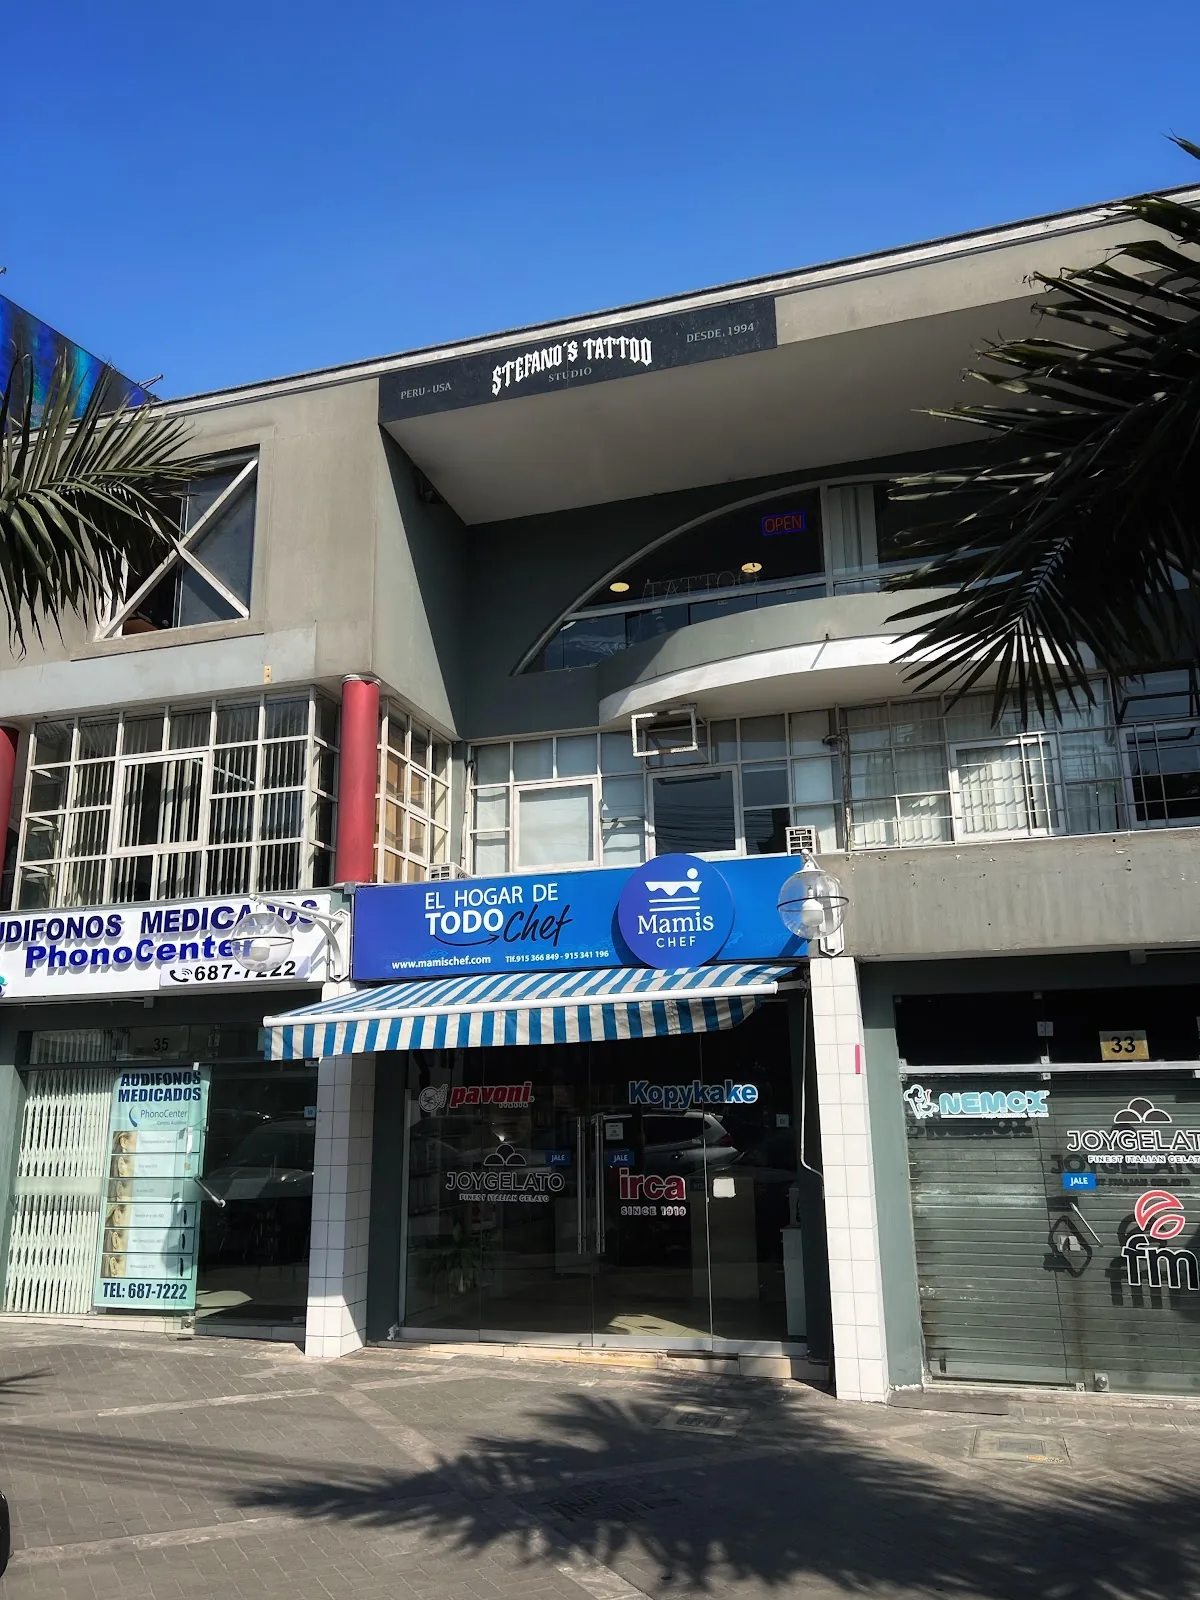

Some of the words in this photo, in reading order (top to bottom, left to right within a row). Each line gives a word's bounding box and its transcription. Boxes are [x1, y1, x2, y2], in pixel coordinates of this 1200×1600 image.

[727, 322, 754, 336] 1994
[582, 335, 653, 366] TATTOO
[548, 367, 593, 382] STUDIO
[400, 387, 426, 400] PERU
[432, 382, 452, 393] USA
[765, 515, 802, 533] OPEN
[425, 892, 445, 910] EL
[454, 886, 523, 908] HOGAR
[533, 883, 558, 902] DE
[424, 908, 504, 936] TODO
[503, 904, 573, 947] Chef
[637, 911, 714, 935] Mamis
[656, 936, 696, 948] CHEF
[391, 955, 491, 970] www.mamischef.com
[530, 954, 544, 962] 366
[545, 953, 559, 962] 849
[564, 952, 579, 960] 915
[579, 951, 593, 959] 341
[595, 950, 609, 958] 196
[152, 1037, 170, 1051] 35
[1111, 1035, 1136, 1054] 33
[120, 1071, 202, 1087] AUDIFONOS
[118, 1087, 202, 1103] MEDICADOS
[450, 1081, 533, 1108] pavoni
[629, 1079, 759, 1109] Kopykake
[140, 1109, 188, 1119] PhonoCenter
[551, 1154, 565, 1163] JALE
[613, 1154, 629, 1163] JALE
[1087, 1154, 1124, 1164] FINEST
[1125, 1154, 1167, 1164] ITALIAN
[445, 1171, 565, 1192] JOYGELATO
[619, 1167, 686, 1200] irca
[1070, 1177, 1089, 1187] JALE
[459, 1193, 486, 1202] FINEST
[487, 1193, 517, 1202] ITALIAN
[519, 1194, 549, 1203] GELATO
[620, 1206, 657, 1216] SINCE
[103, 1282, 125, 1298] TEL:
[128, 1282, 188, 1300] 687-7222
